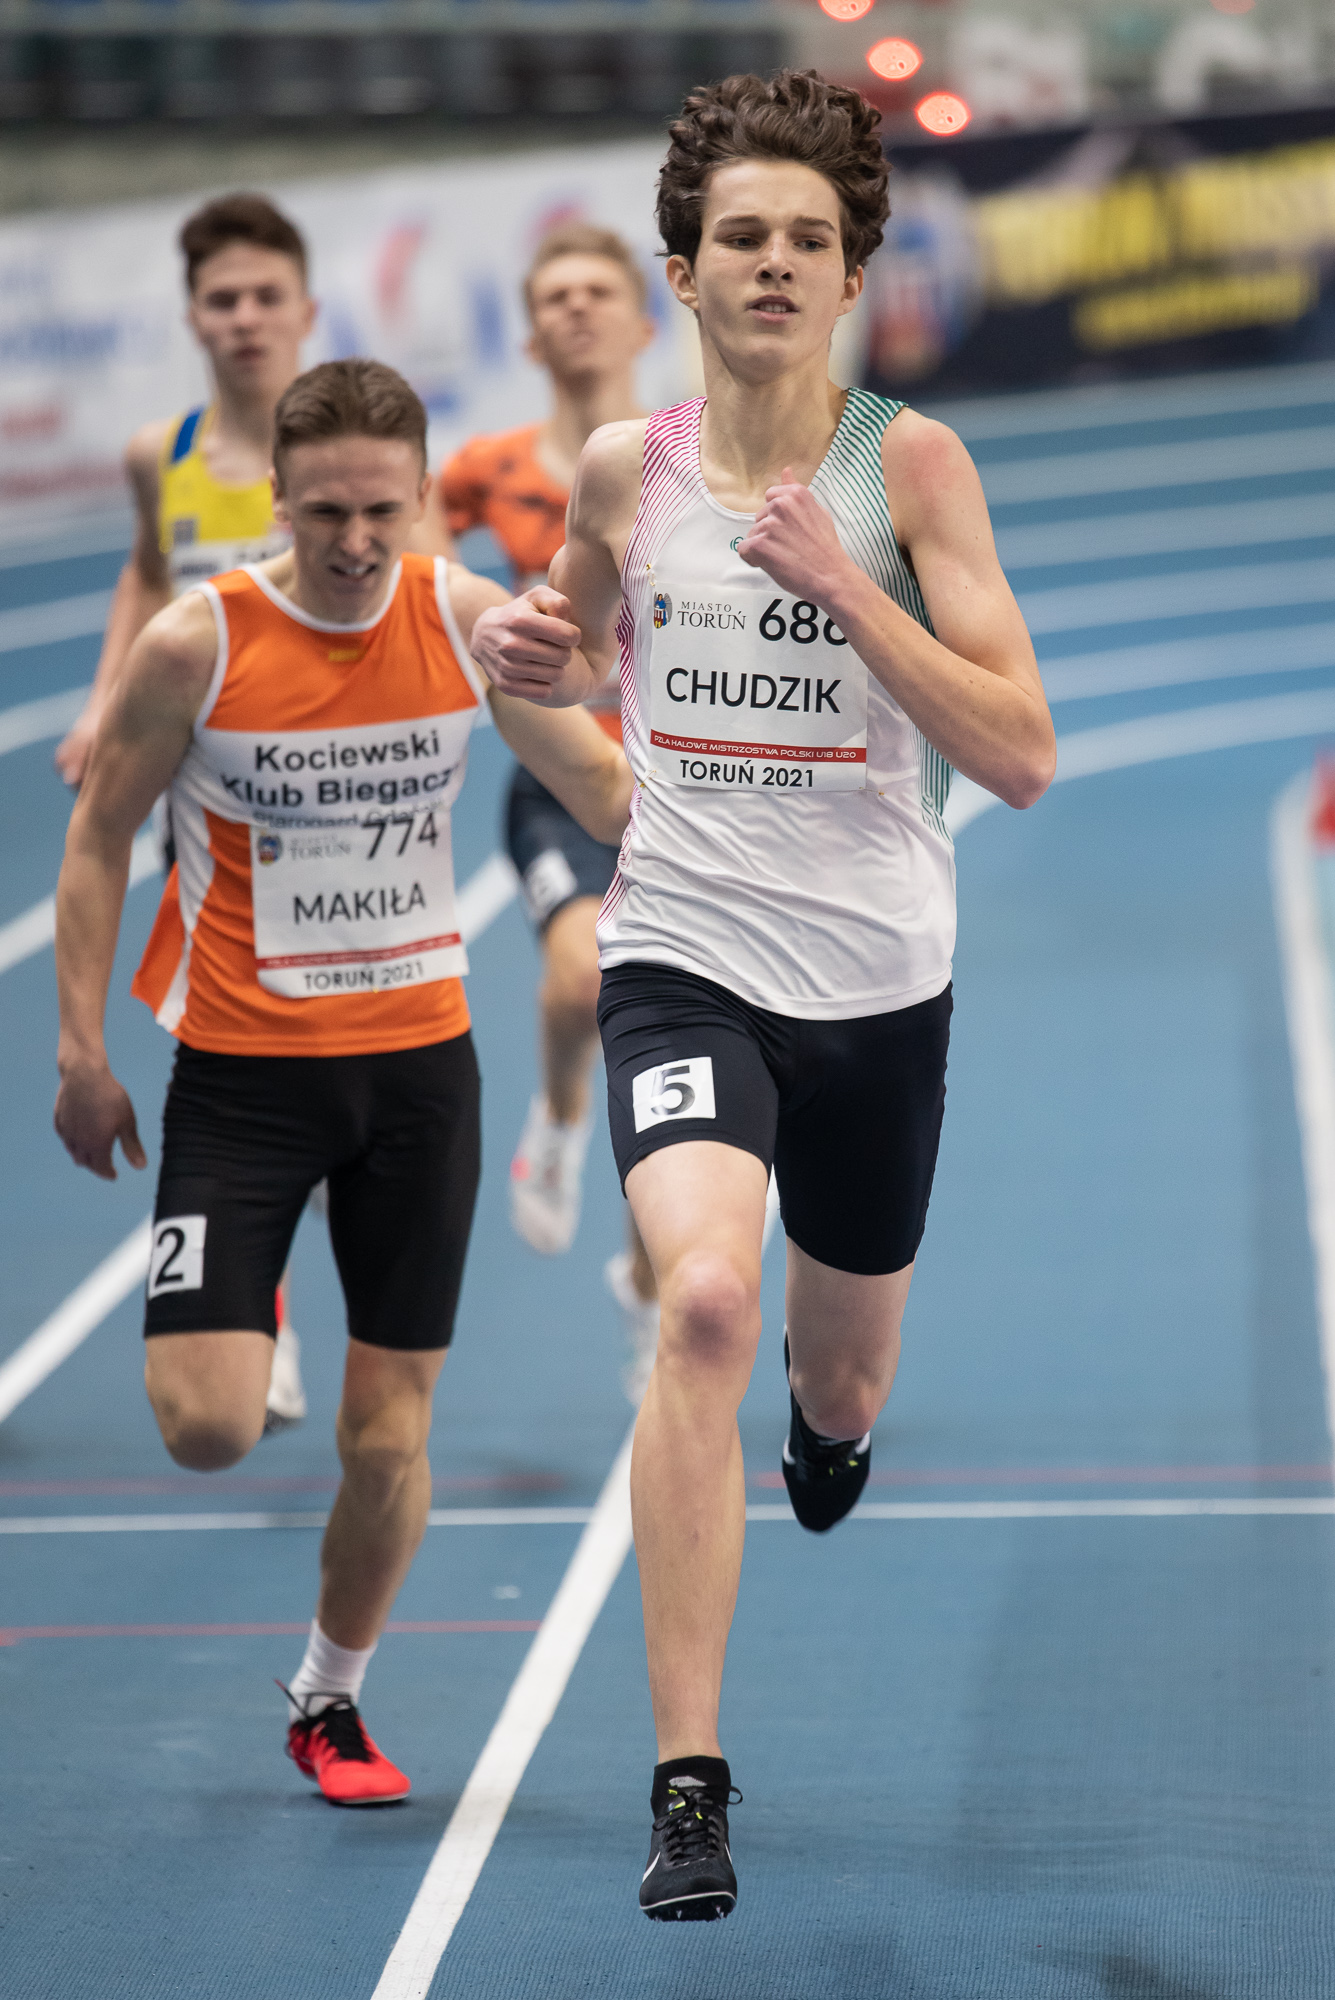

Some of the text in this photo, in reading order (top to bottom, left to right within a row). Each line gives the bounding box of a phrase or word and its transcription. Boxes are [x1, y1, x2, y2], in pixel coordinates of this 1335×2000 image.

[677, 610, 747, 630] TORUŃ
[680, 601, 732, 613] MIASTO
[666, 667, 842, 714] CHUDZIK
[255, 729, 440, 773] Kociewski
[654, 735, 857, 759] PZLA HALOWE MISTRZOSTWA POLSKI U18 U20
[220, 773, 304, 808] Klub
[680, 759, 813, 788] TORUŃ 2021
[362, 812, 439, 861] 774
[293, 881, 427, 925] MAKIŁA
[304, 960, 424, 990] TORUŃ 2021
[651, 1065, 696, 1116] 5
[155, 1227, 186, 1288] 2
